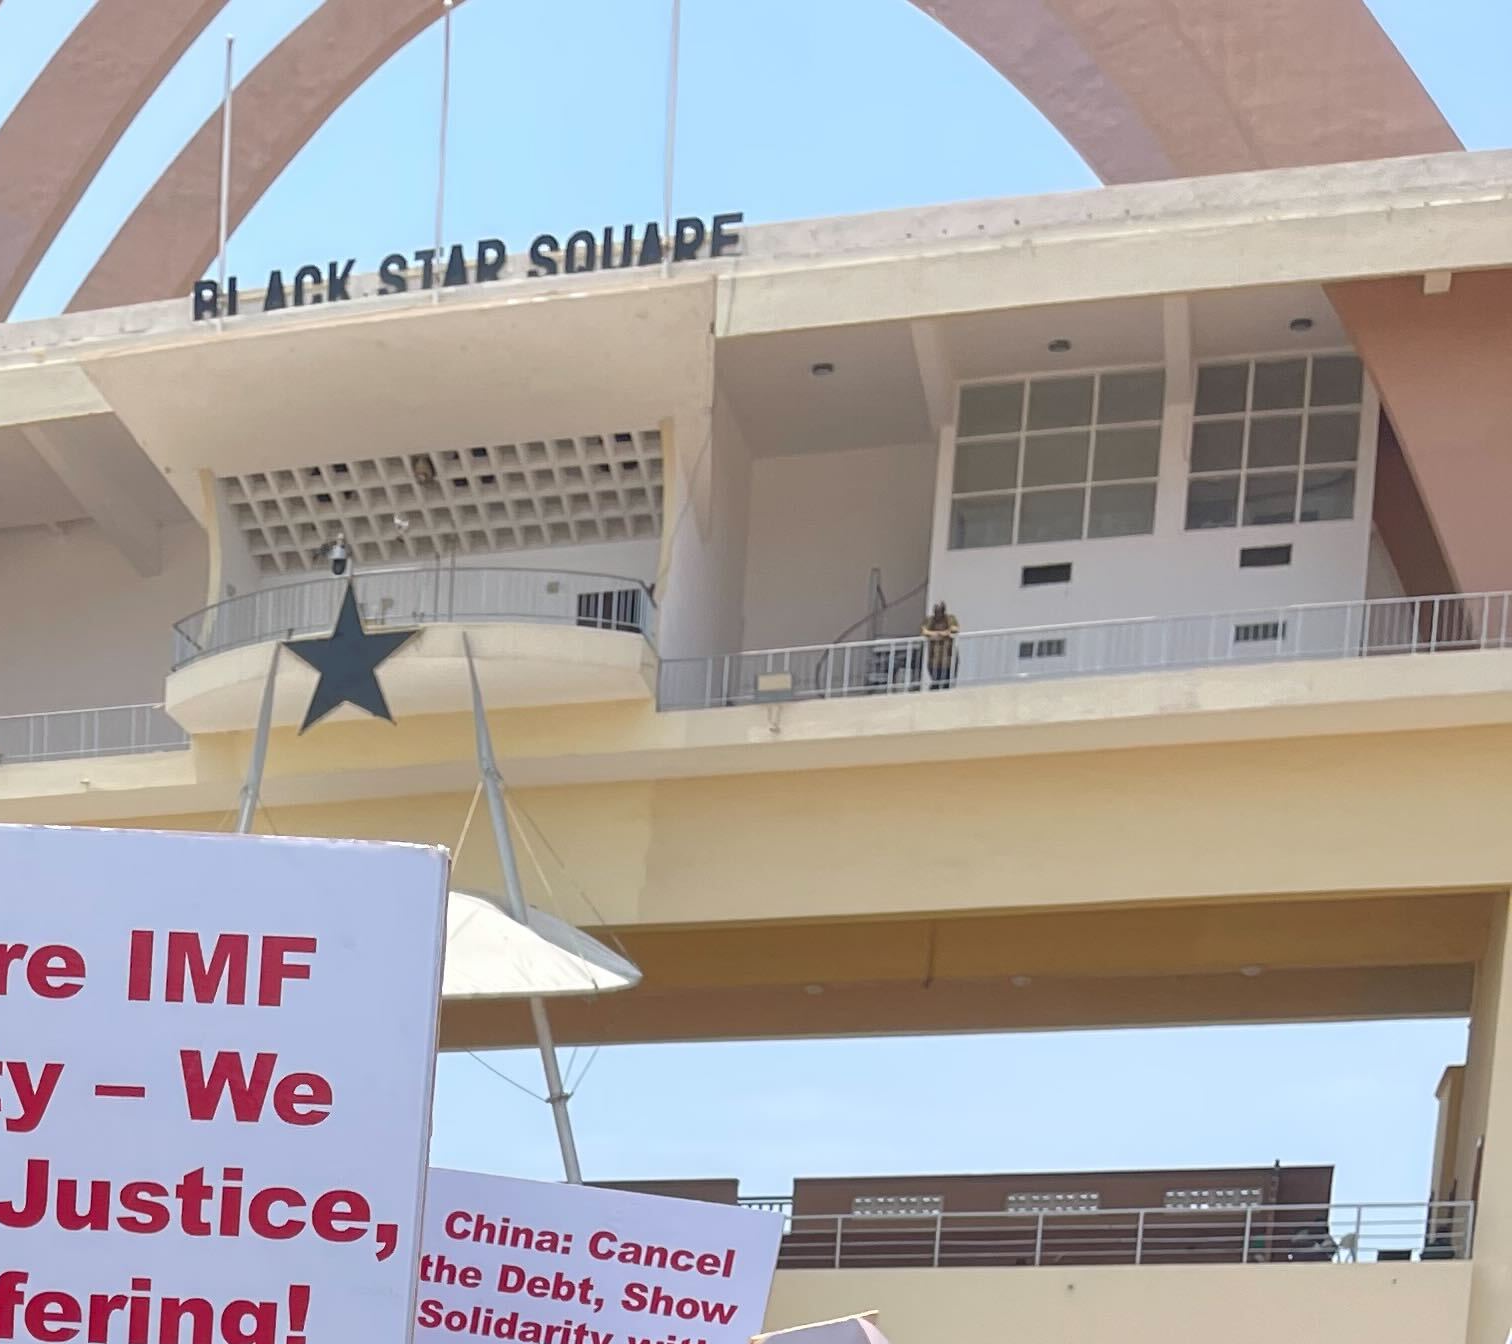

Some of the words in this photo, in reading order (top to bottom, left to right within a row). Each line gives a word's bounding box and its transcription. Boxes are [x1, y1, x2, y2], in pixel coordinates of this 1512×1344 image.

[378, 237, 506, 297] STAR
[528, 213, 743, 277] SQUARE
[129, 931, 317, 1006] IMF
[180, 1050, 333, 1126] We
[444, 1211, 573, 1255] China:
[589, 1231, 736, 1278] Cancel
[419, 1254, 483, 1288] the
[497, 1264, 605, 1313] Debt,
[621, 1283, 738, 1325] Show
